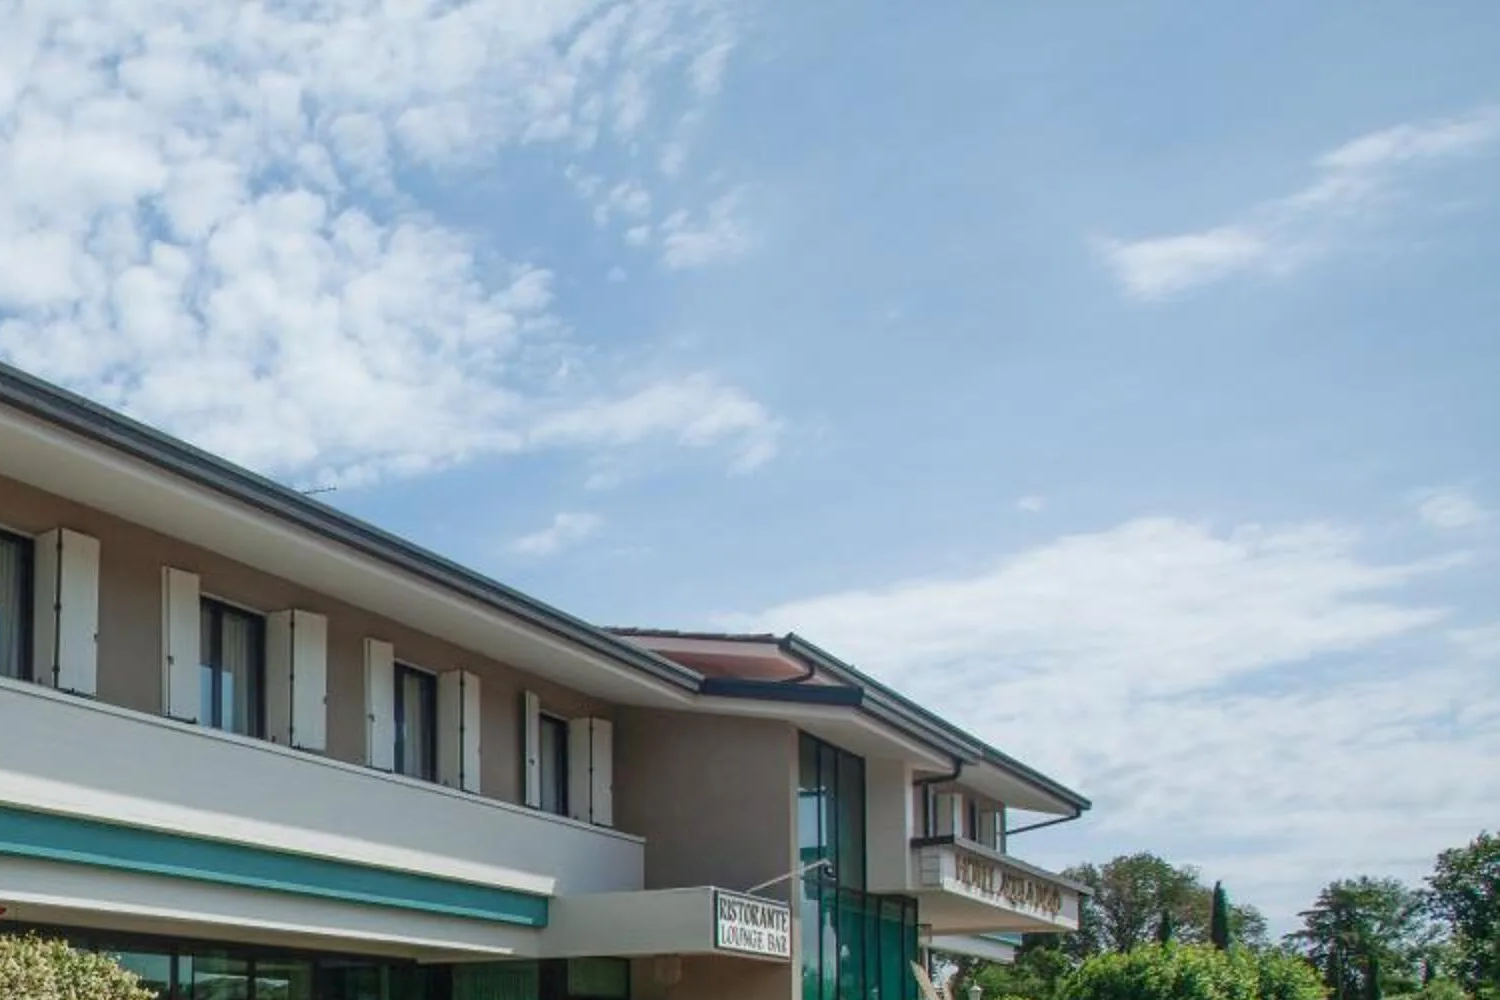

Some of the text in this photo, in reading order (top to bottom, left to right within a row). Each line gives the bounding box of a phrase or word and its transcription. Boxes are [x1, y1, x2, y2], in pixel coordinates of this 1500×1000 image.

[719, 897, 788, 932] RISTORANTE
[721, 923, 787, 953] LOUNGE BAR
